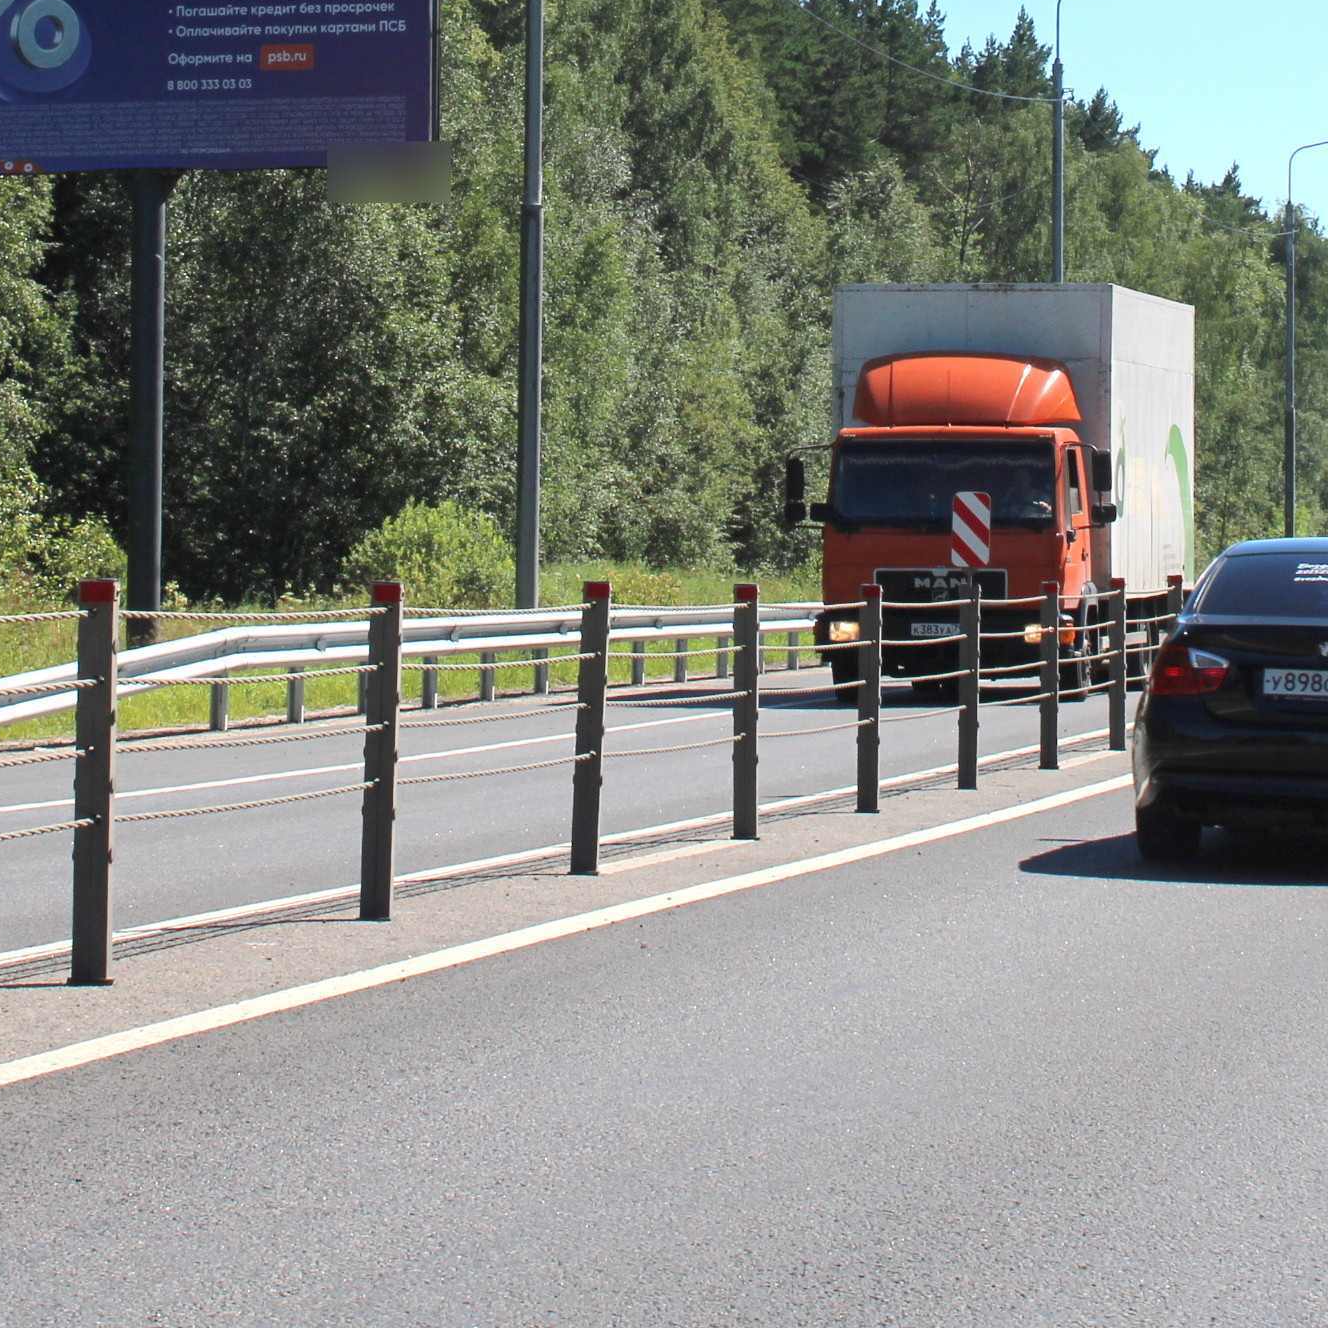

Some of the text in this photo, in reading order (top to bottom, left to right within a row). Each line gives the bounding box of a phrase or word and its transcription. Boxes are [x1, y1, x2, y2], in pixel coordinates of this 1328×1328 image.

[176, 2, 395, 17] Погашайте кредит без просрочек
[175, 19, 407, 37] Оплачивайте покупки картами ПСБ
[167, 50, 307, 67] Оформите на psb.ru
[167, 78, 252, 91] 8 800 333 03 03
